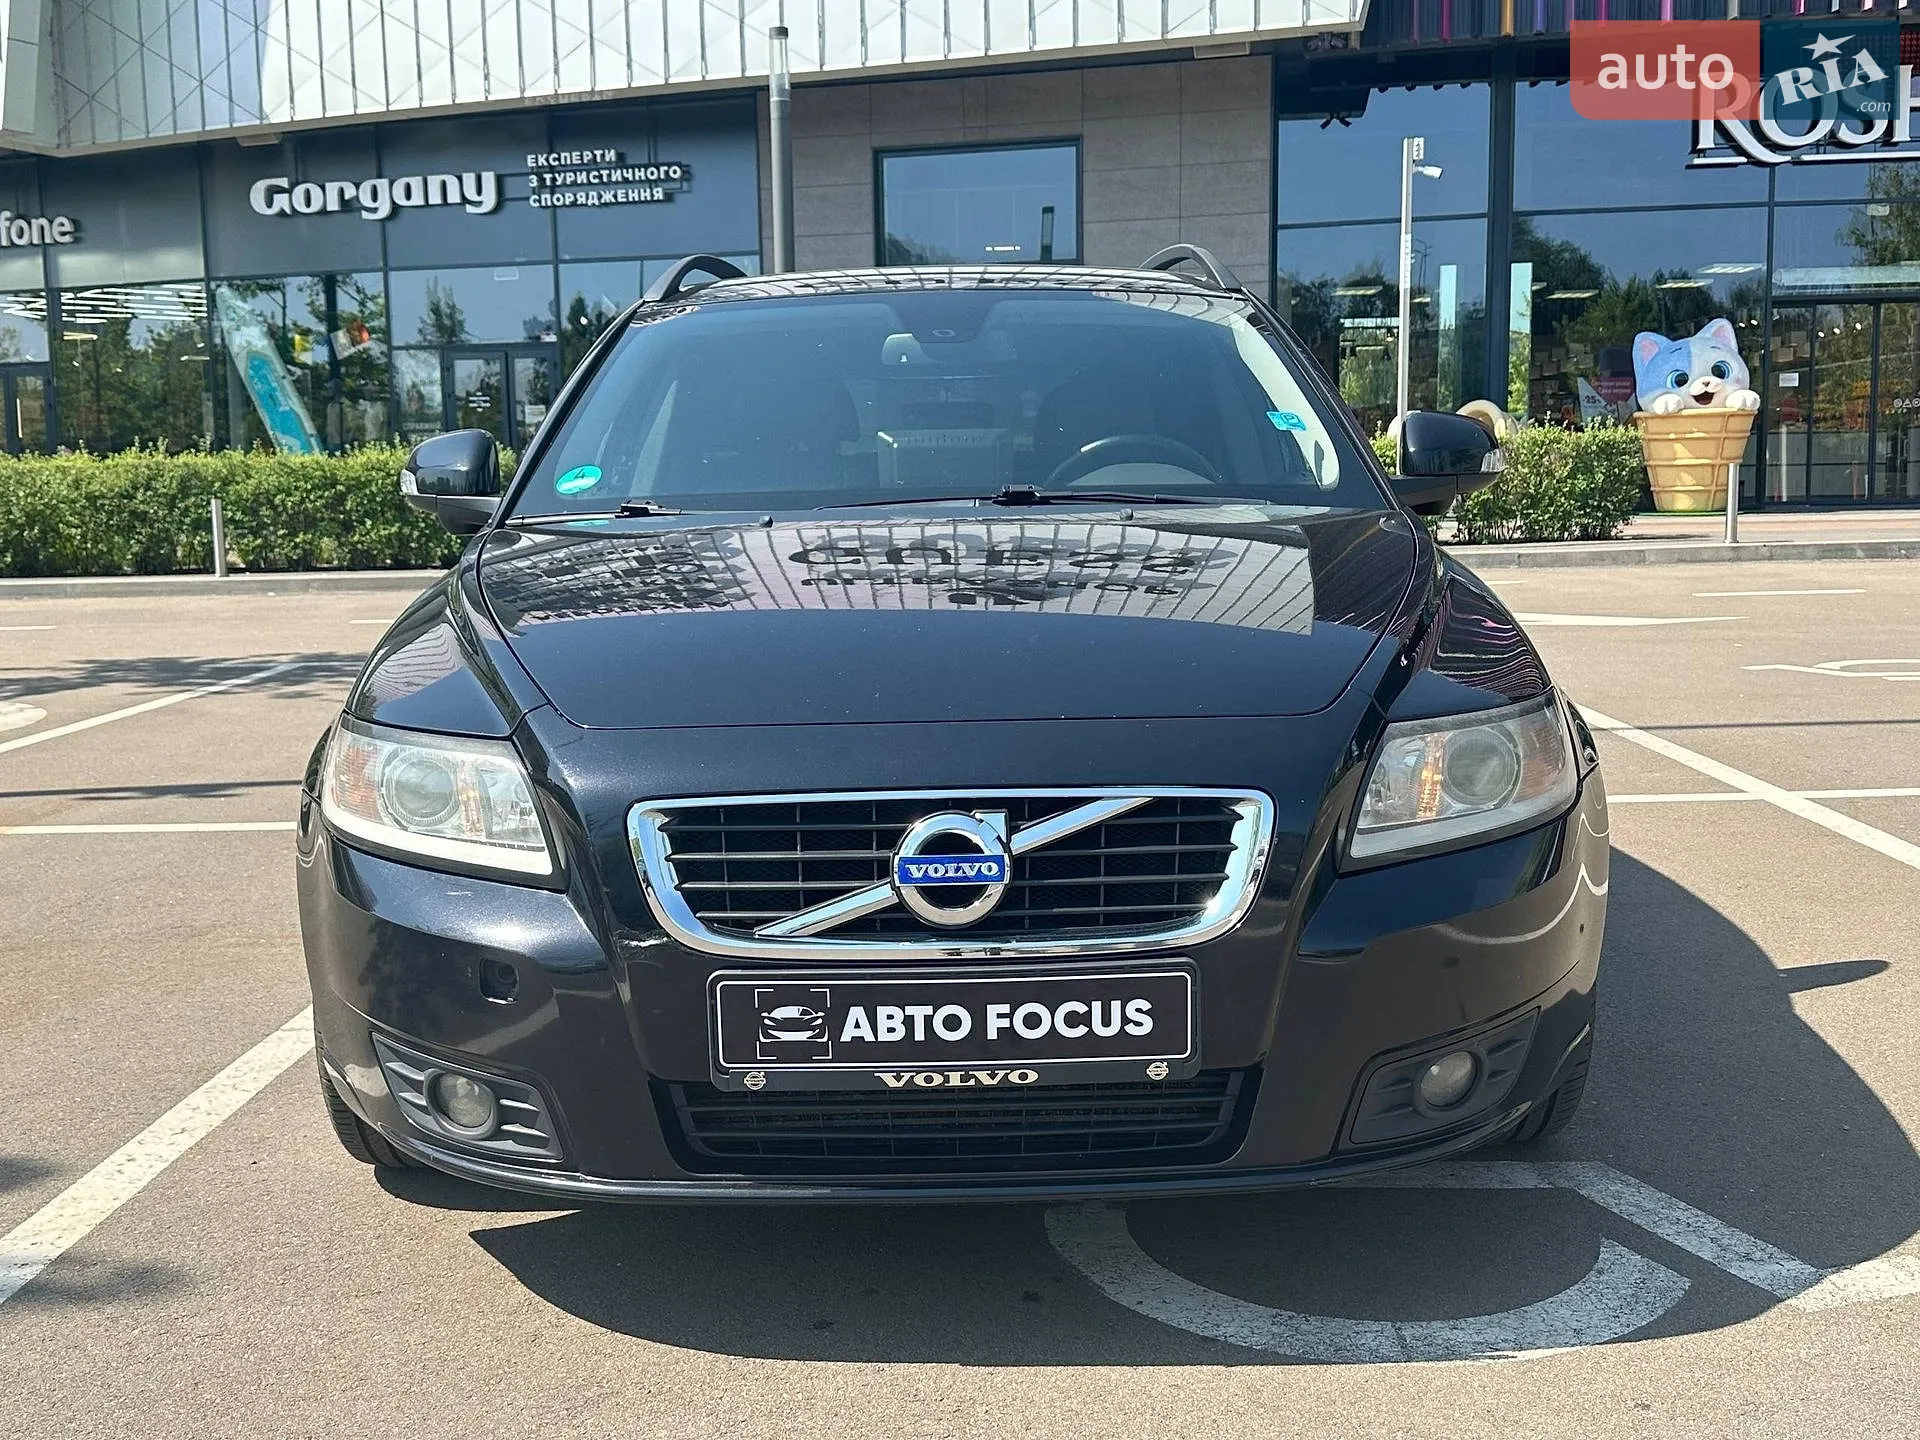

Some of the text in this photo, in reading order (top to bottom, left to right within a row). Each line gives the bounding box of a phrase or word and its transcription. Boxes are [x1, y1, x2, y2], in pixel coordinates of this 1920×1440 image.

[526, 148, 616, 167] ЕКСПЕРТИ
[543, 164, 683, 187] ТУРИСТИЧНОГО
[249, 170, 498, 220] Gorgany
[529, 187, 665, 208] СПОРЯДЖЕННЯ
[905, 861, 1000, 879] VOLVO
[839, 998, 1155, 1044] АВТО FOCUS
[874, 1067, 1040, 1089] VOLVO
